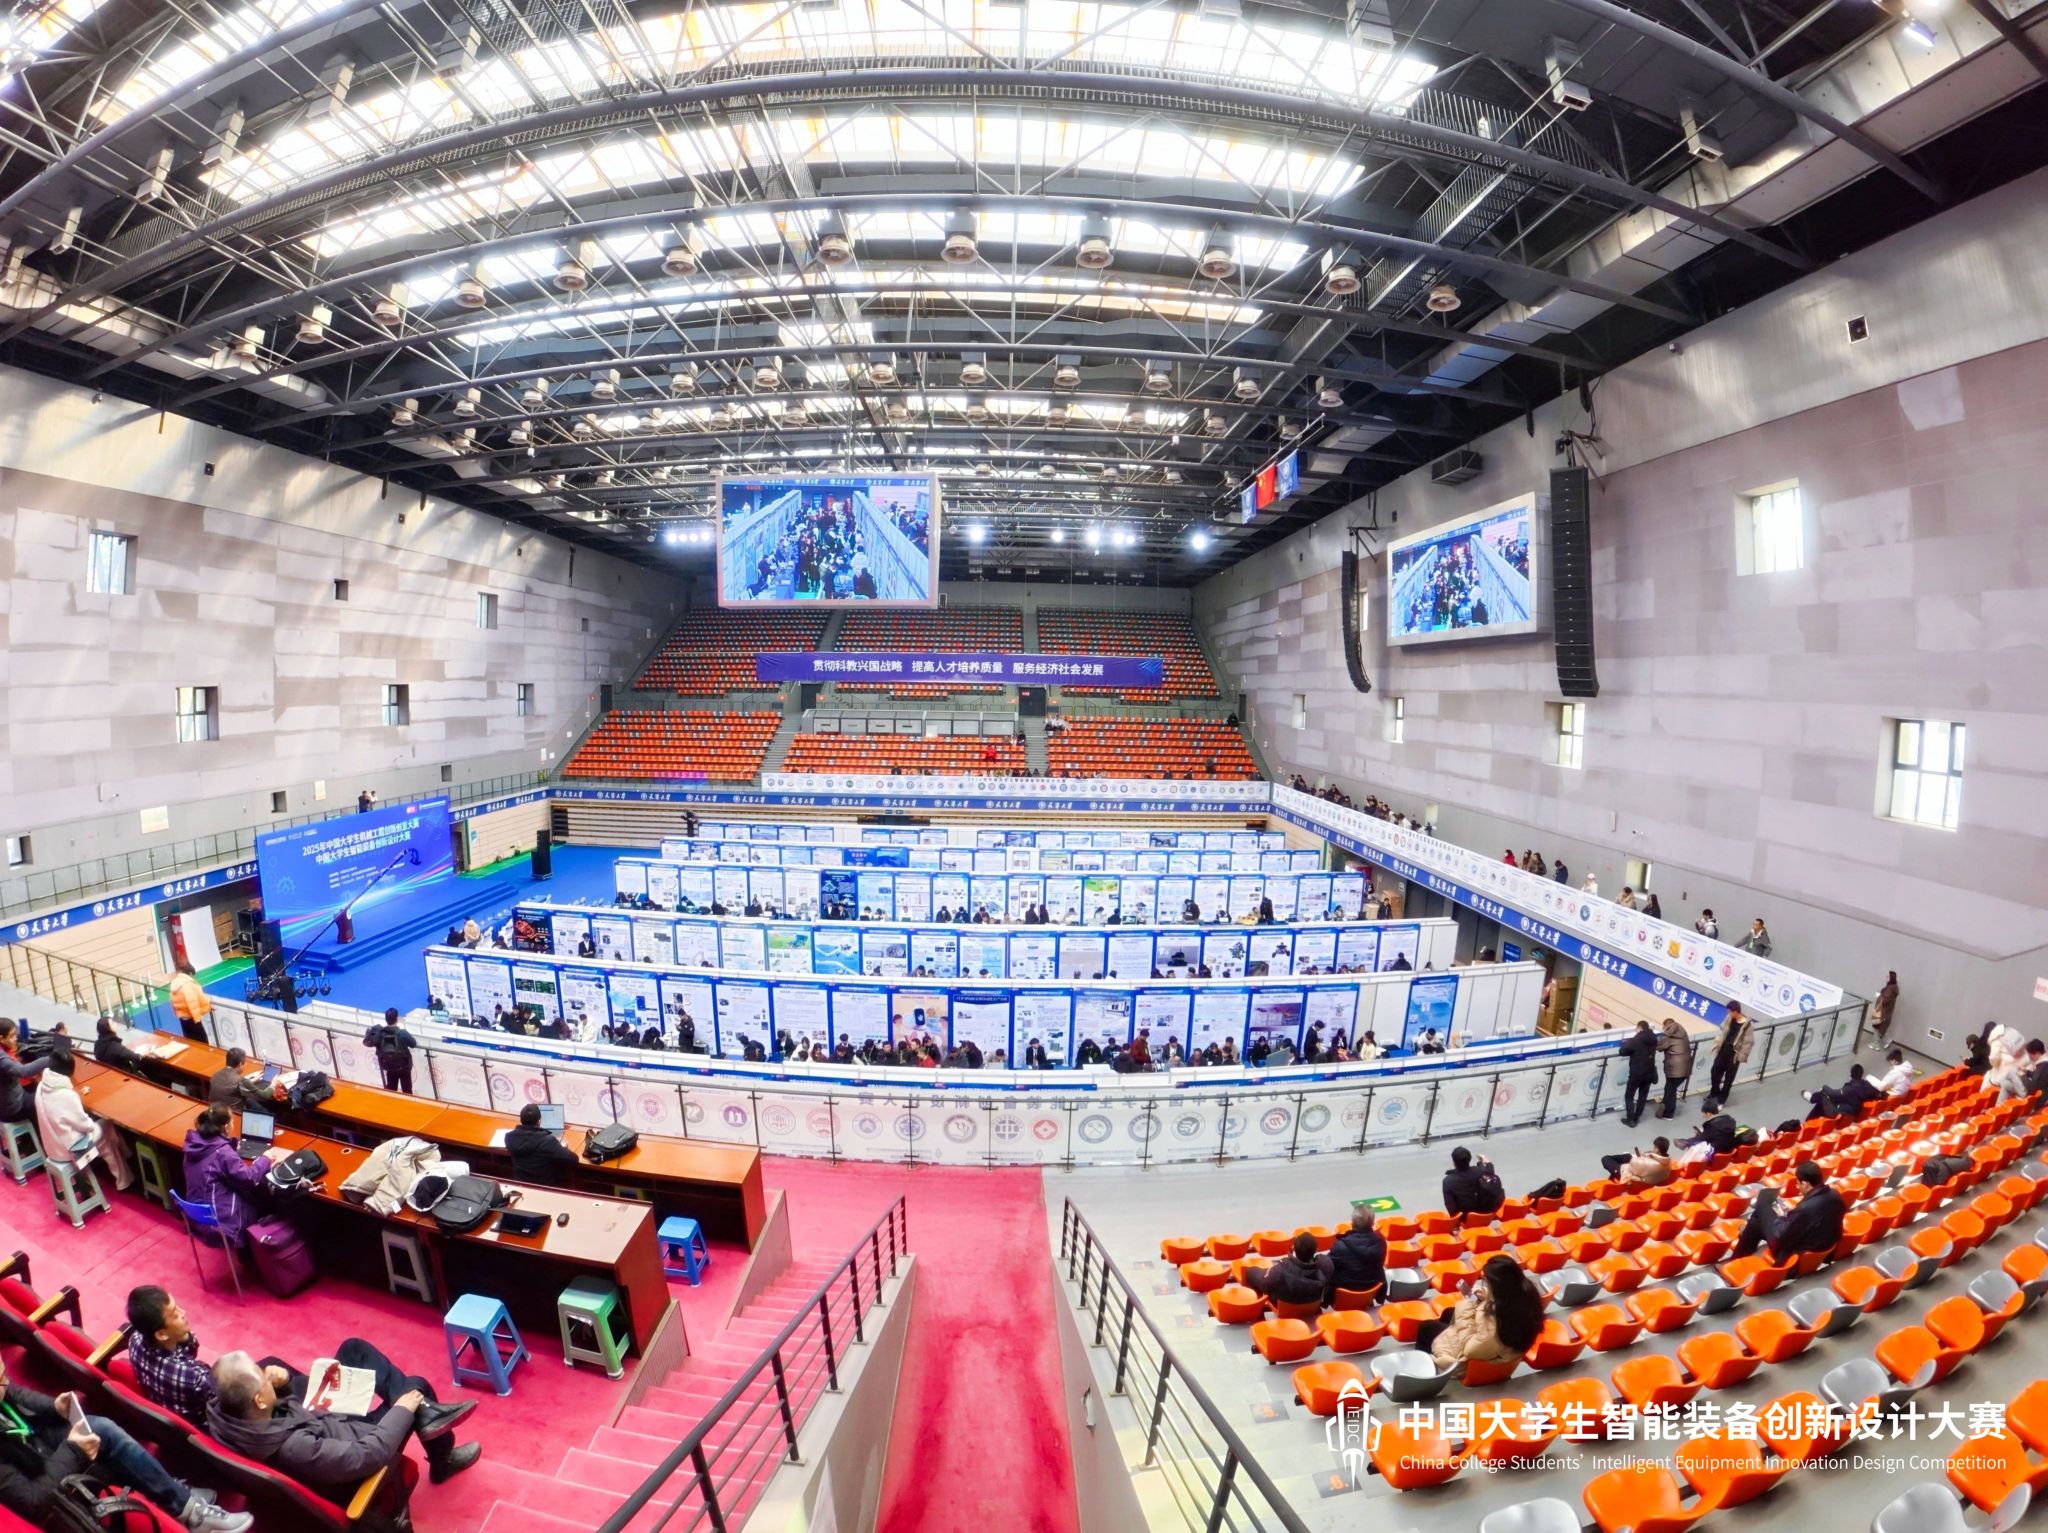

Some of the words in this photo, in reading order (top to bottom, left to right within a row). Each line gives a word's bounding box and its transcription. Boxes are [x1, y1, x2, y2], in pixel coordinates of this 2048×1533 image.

[813, 660, 903, 672] 贯彻科教兴国战略
[911, 661, 1003, 674] 提高人才培养质量
[1012, 662, 1104, 676] 服务经济社会发展
